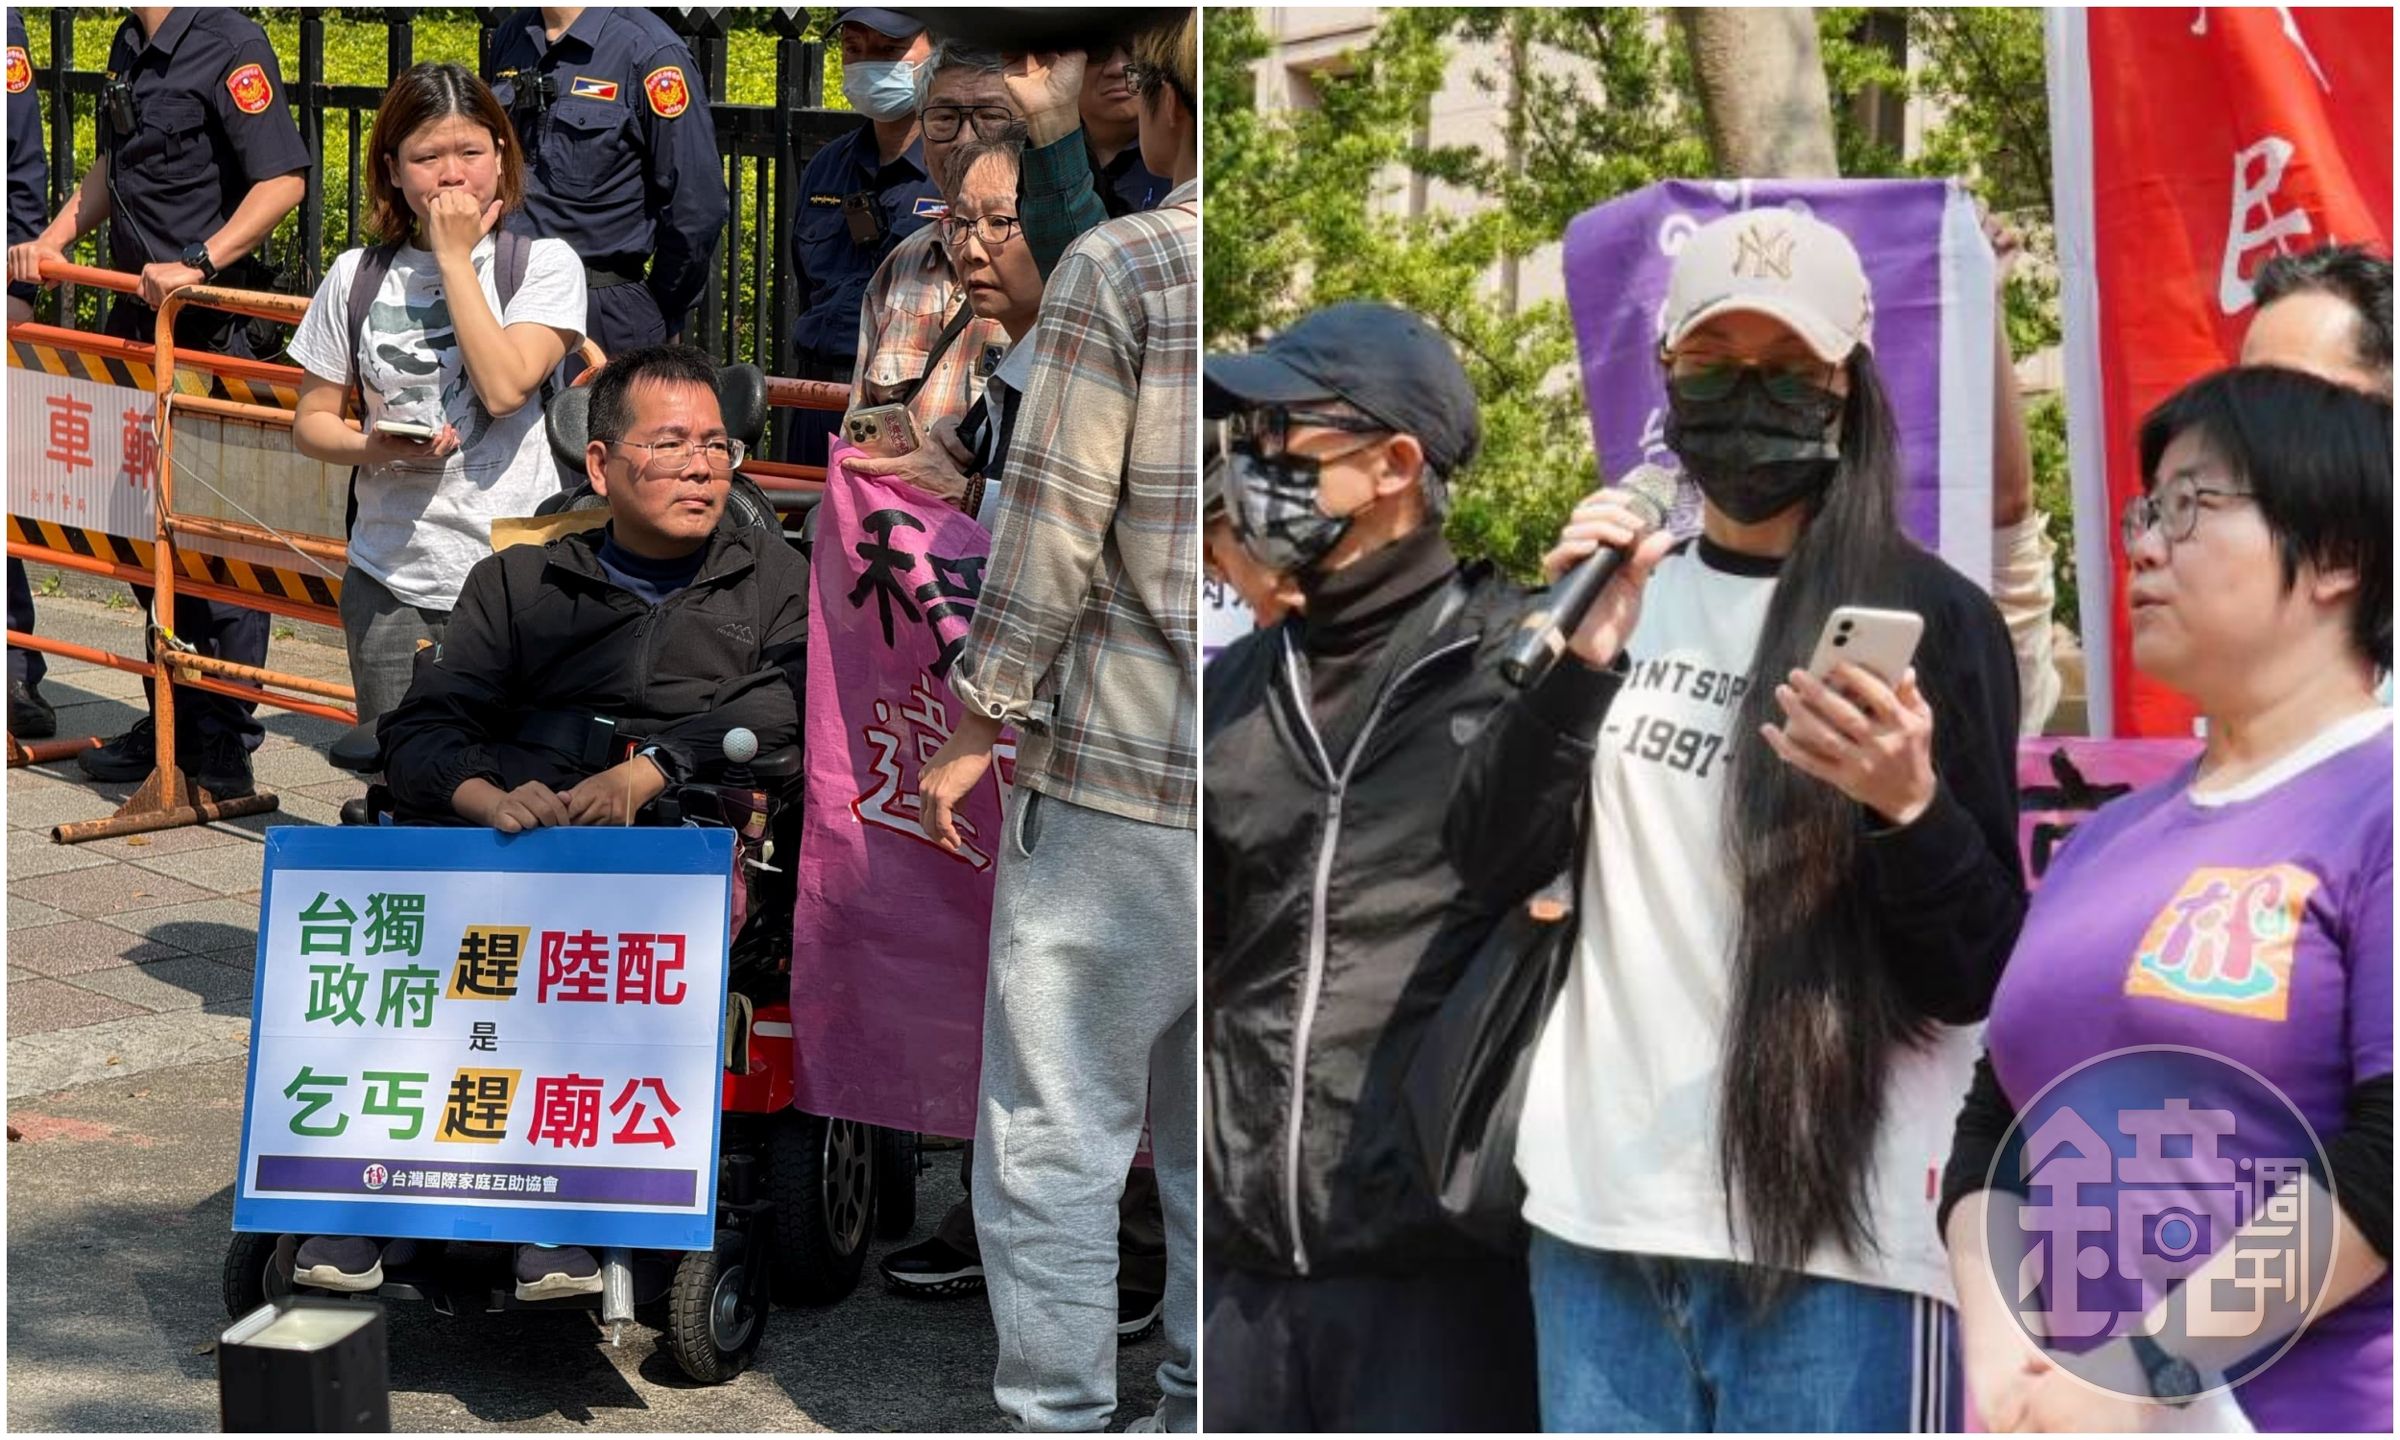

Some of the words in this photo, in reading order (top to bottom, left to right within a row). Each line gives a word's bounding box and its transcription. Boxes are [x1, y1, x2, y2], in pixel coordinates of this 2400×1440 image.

[298, 891, 427, 957] 台獨
[304, 962, 441, 1028] 政府
[468, 1021, 498, 1052] 是
[391, 1169, 560, 1193] 台灣國際家庭互助協會
